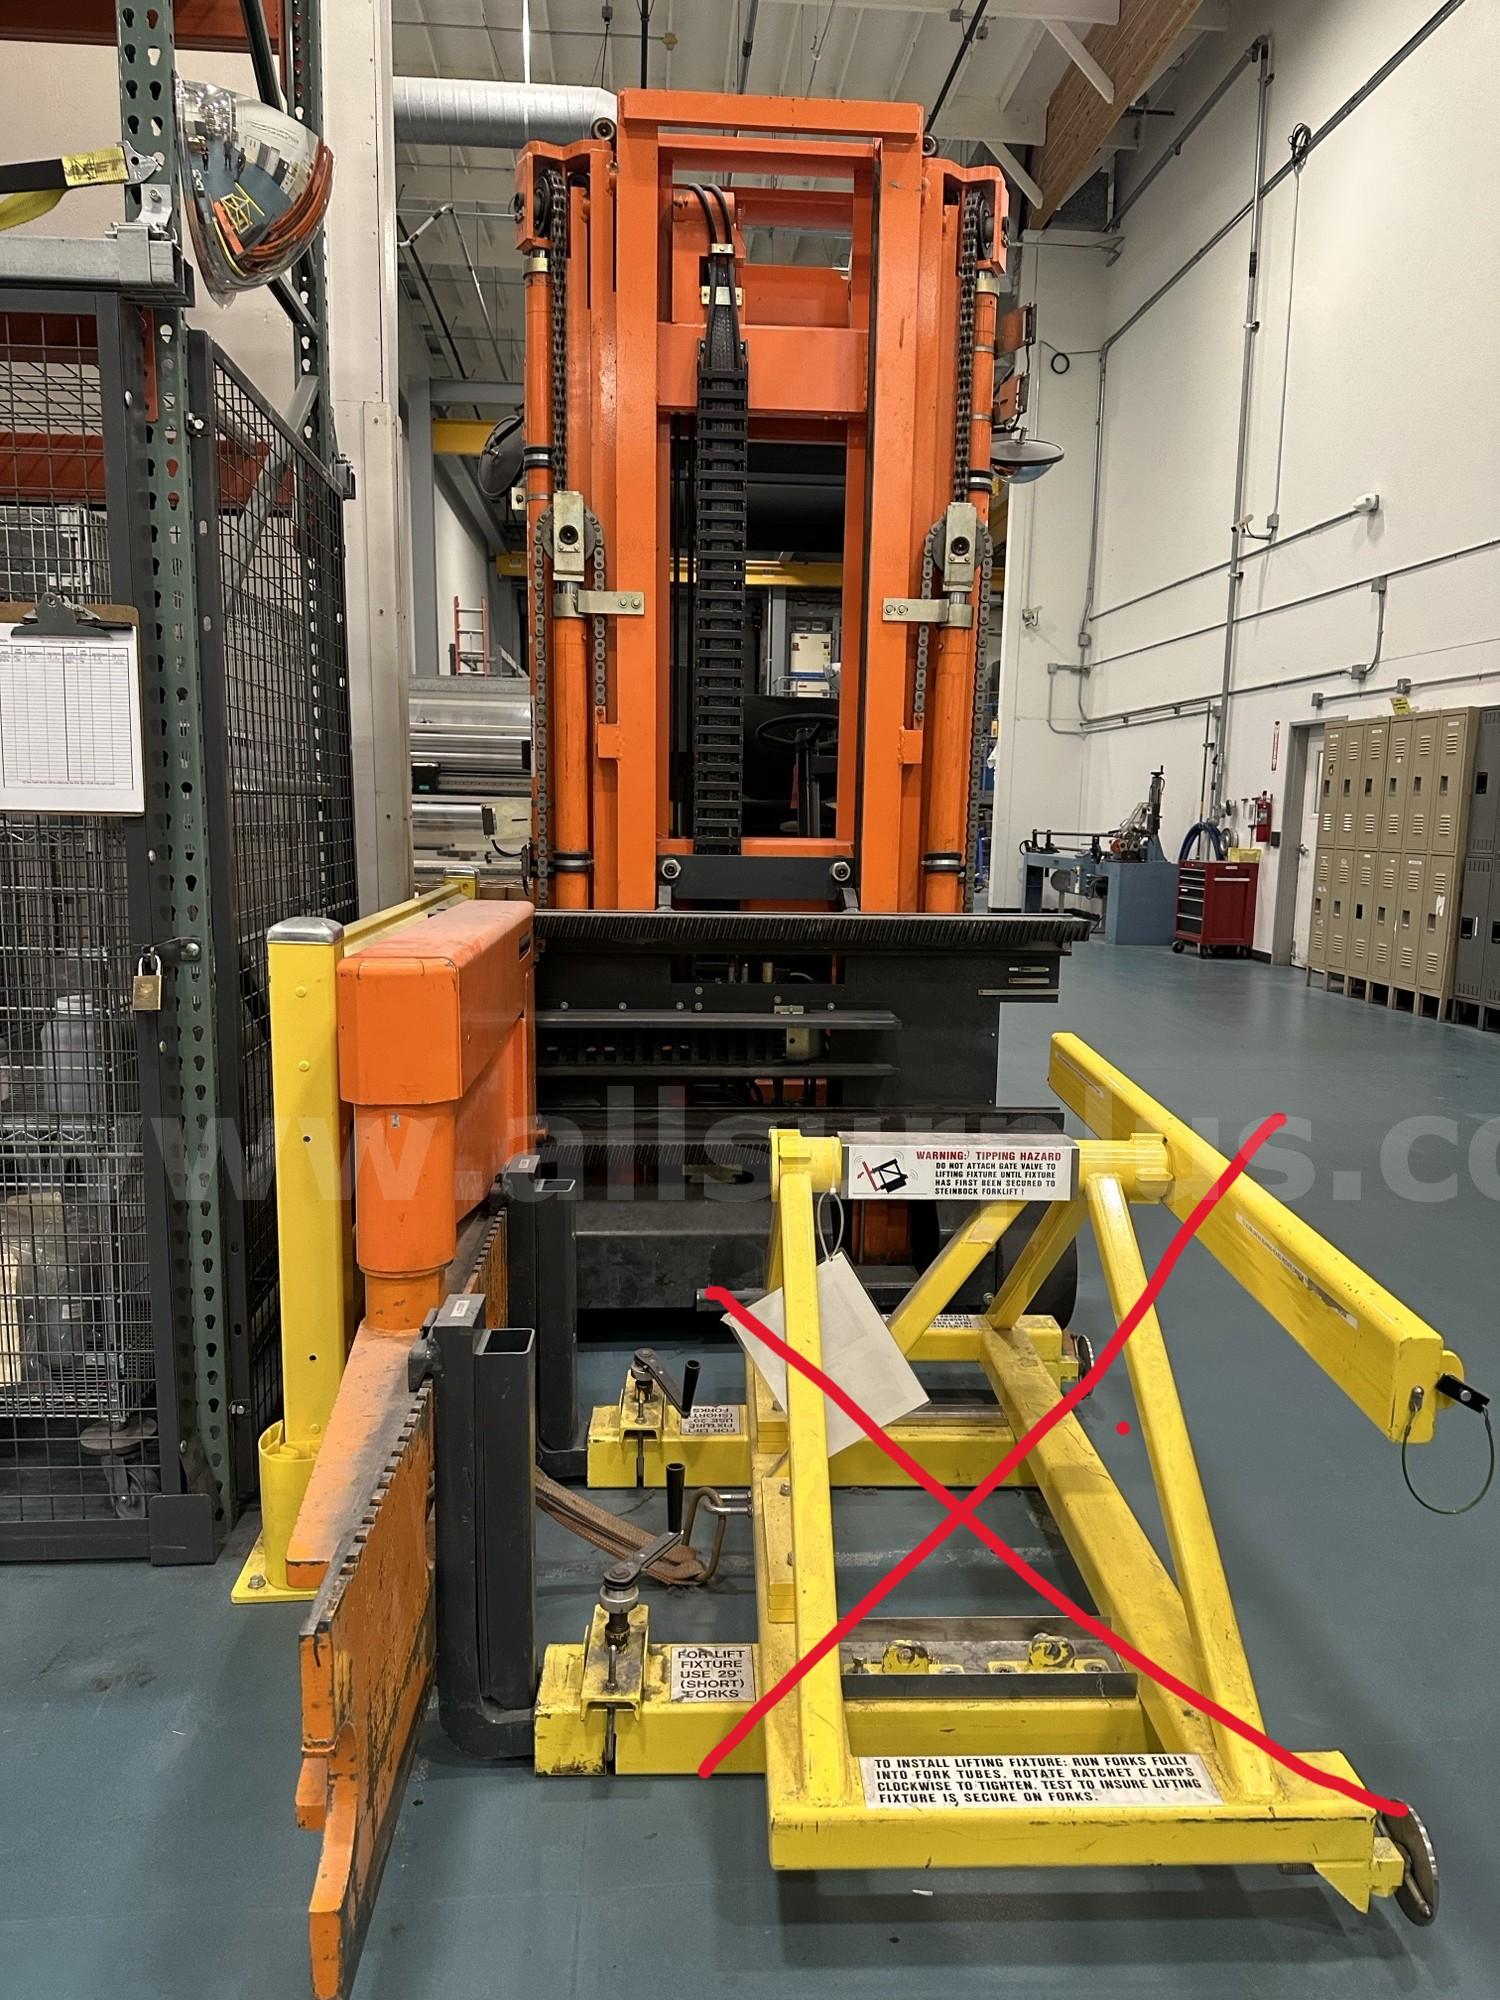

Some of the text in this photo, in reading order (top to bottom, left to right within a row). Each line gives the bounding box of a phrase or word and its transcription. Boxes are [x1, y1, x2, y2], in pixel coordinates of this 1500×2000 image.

[916, 1151, 1062, 1161] WARNING: TIPPING HAZARD
[678, 1650, 708, 1658] FOR
[681, 1660, 742, 1668] FIXTURE
[680, 1670, 710, 1678] USE
[680, 1679, 744, 1688] (SHORT)
[875, 1756, 1188, 1768] TO INSTALL LIFTING FIXTURE: RUN FORKS FULLY
[876, 1768, 1194, 1780] INTO FORK TUBES. ROTATE RATCHET CLAMPS
[878, 1778, 1202, 1791] CLOCKWISE TO TIGHTEN. TEST TO INSURE LIFTING
[880, 1794, 936, 1803] FIXTURE
[964, 1792, 1017, 1802] SECURE
[1024, 1792, 1042, 1802] ON
[1050, 1792, 1098, 1801] FORKS.
